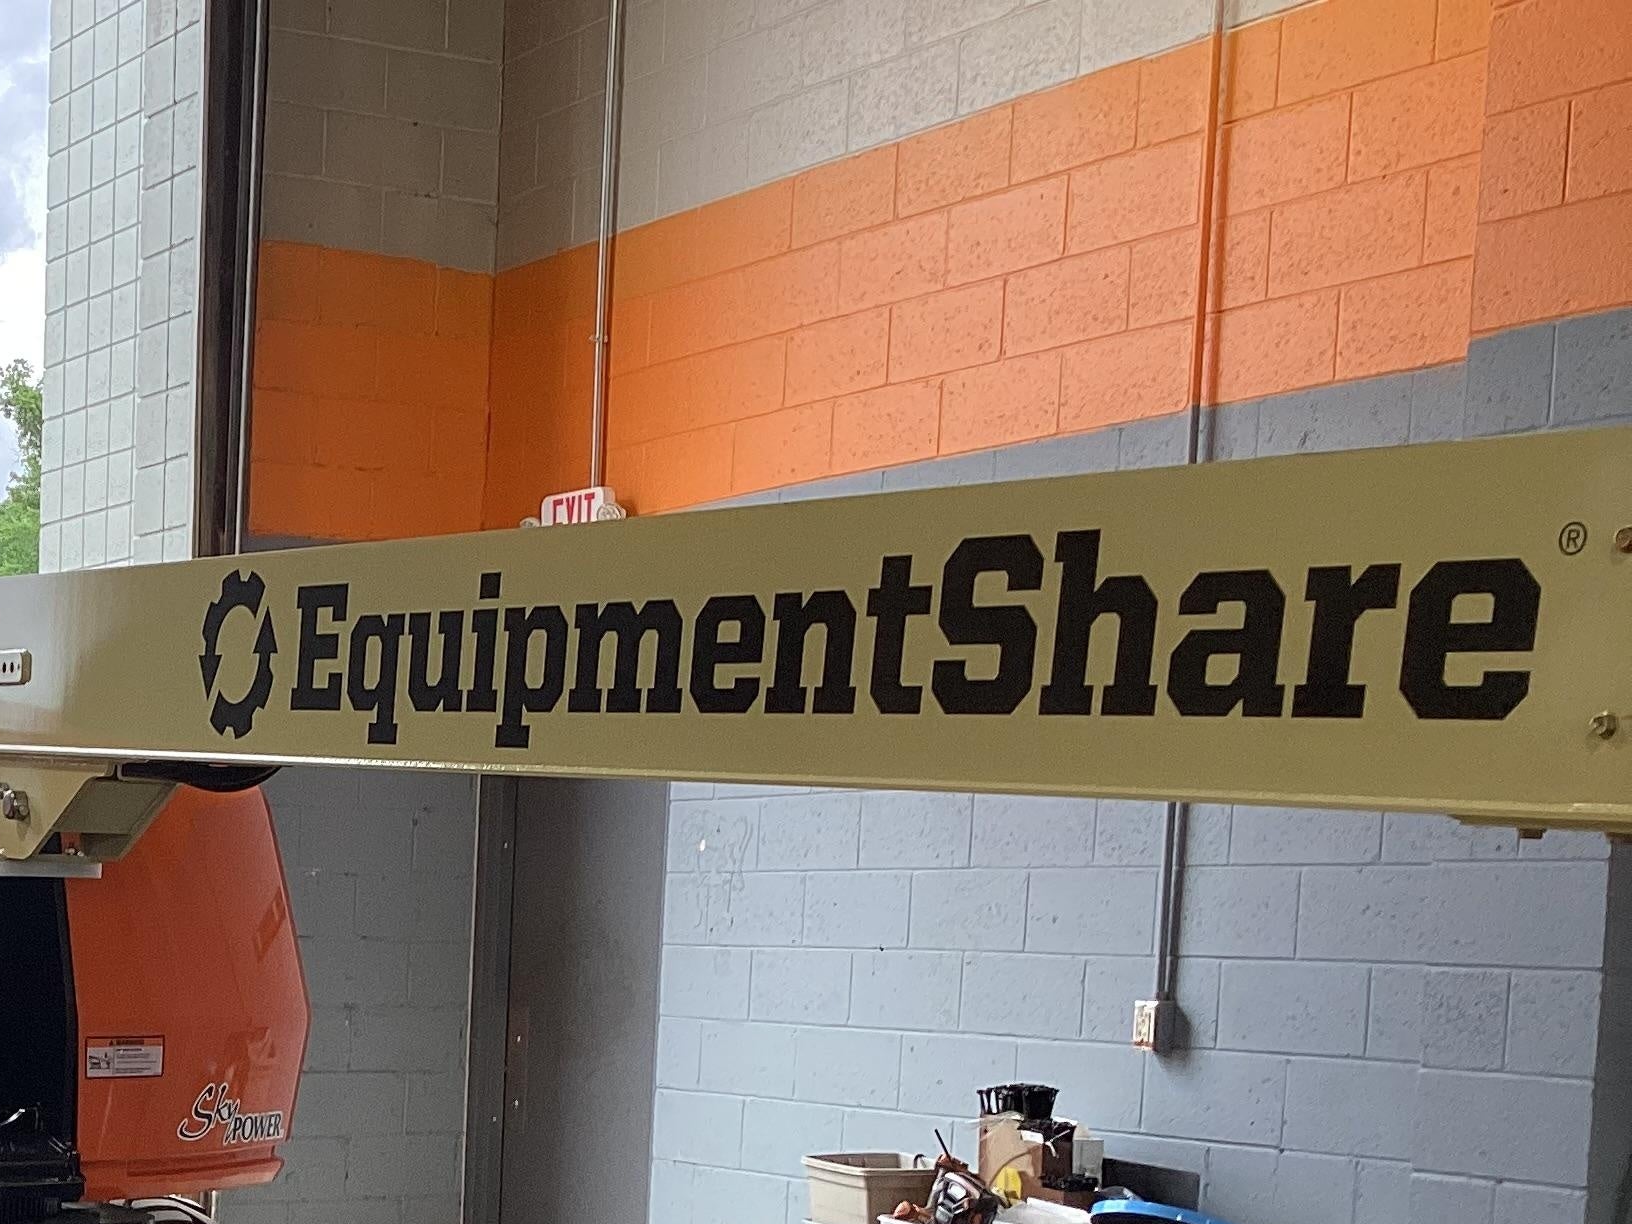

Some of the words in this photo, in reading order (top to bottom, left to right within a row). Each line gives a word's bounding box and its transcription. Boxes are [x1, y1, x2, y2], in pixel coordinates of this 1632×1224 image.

[290, 528, 1542, 748] EquipmentShare
[177, 1083, 241, 1146] Sky
[229, 1111, 284, 1144] POWER
